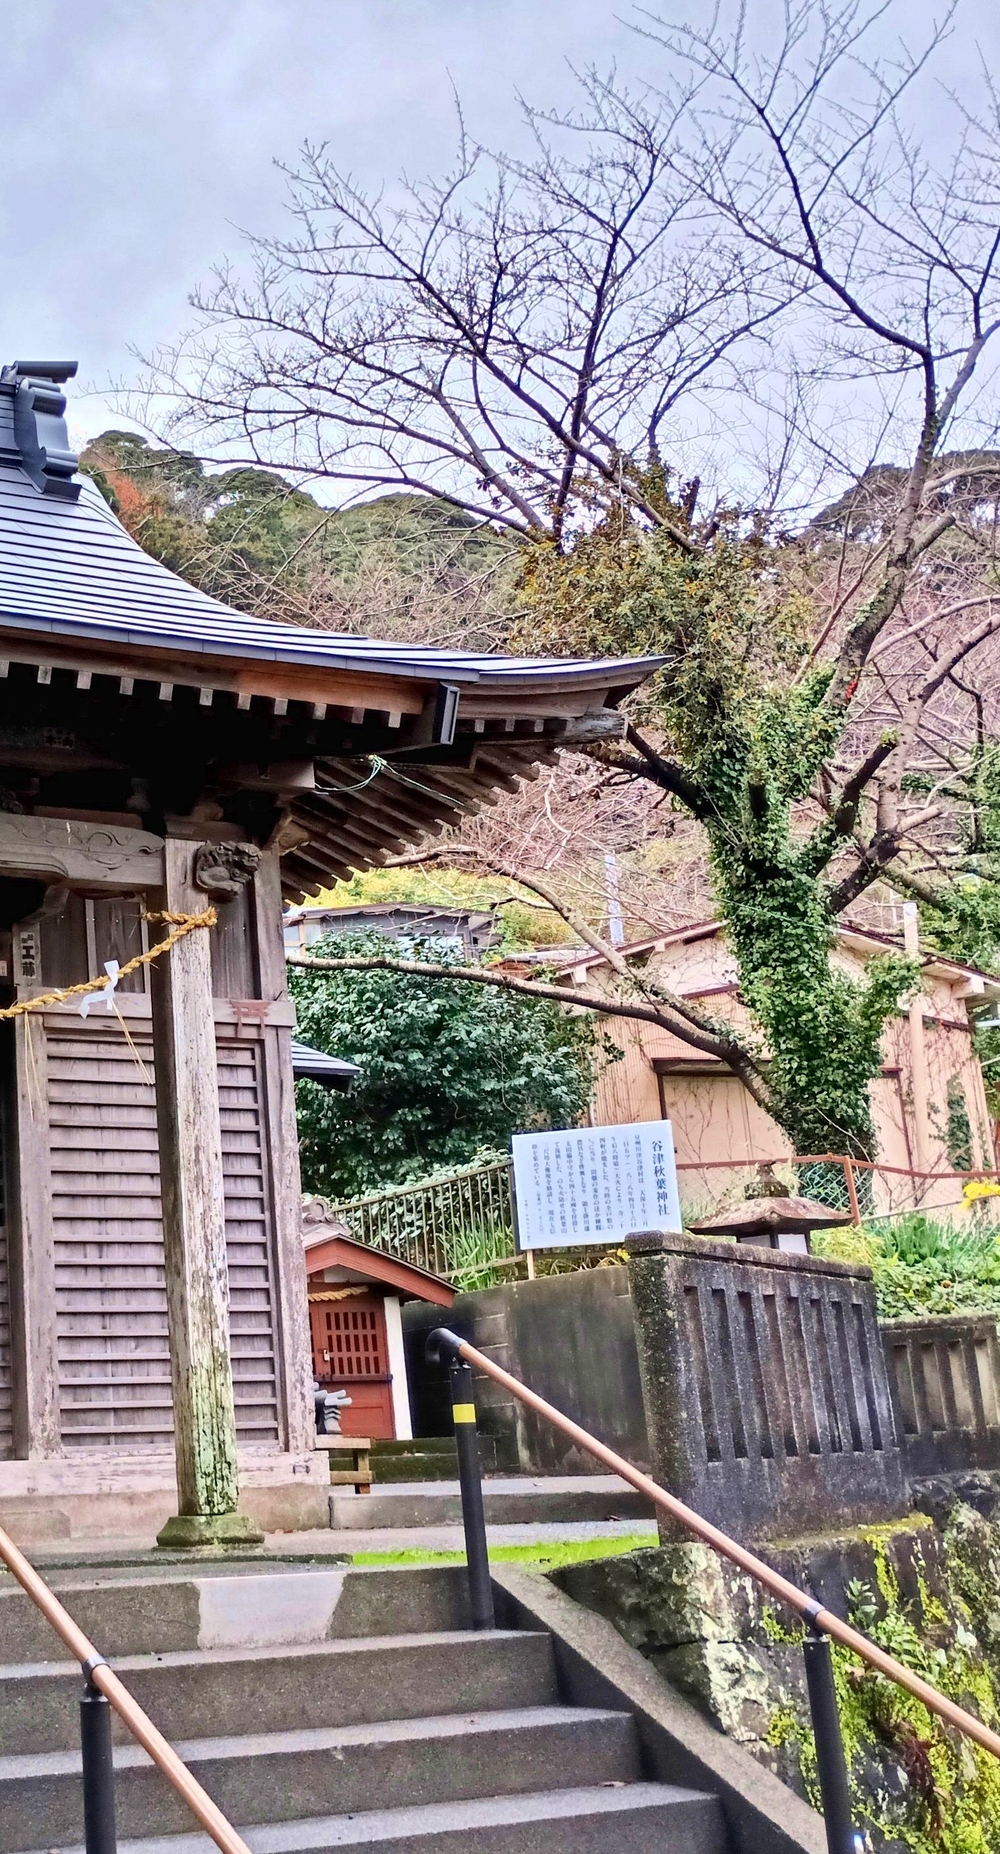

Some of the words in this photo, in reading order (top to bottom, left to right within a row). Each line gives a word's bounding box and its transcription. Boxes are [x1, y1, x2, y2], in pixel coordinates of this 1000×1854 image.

[22, 945, 36, 978] 工藤
[650, 1139, 670, 1216] 谷津秋葉神社
